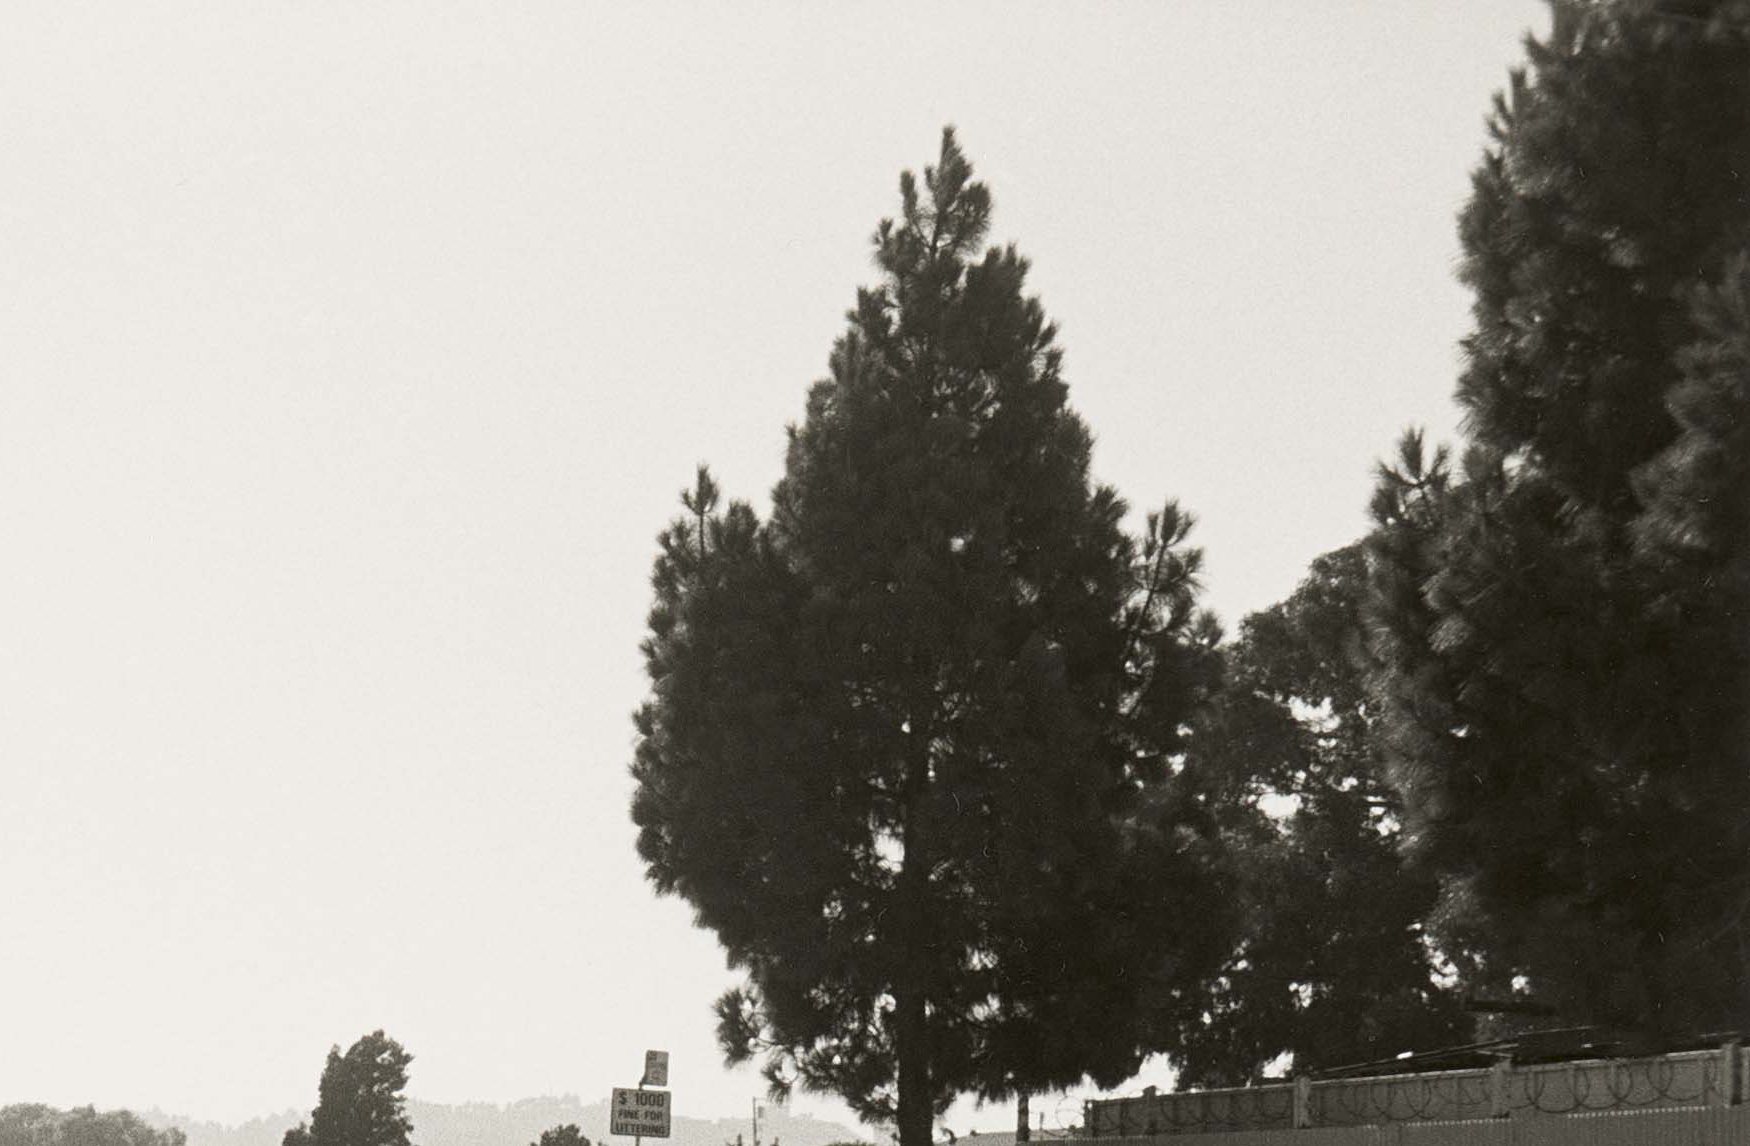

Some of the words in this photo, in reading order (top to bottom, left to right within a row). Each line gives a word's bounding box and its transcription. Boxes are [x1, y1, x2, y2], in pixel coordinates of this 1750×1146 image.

[634, 1092, 664, 1107] 1000
[618, 1109, 639, 1120] FINE
[644, 1110, 663, 1121] FOR
[615, 1122, 666, 1135] LITTERING
